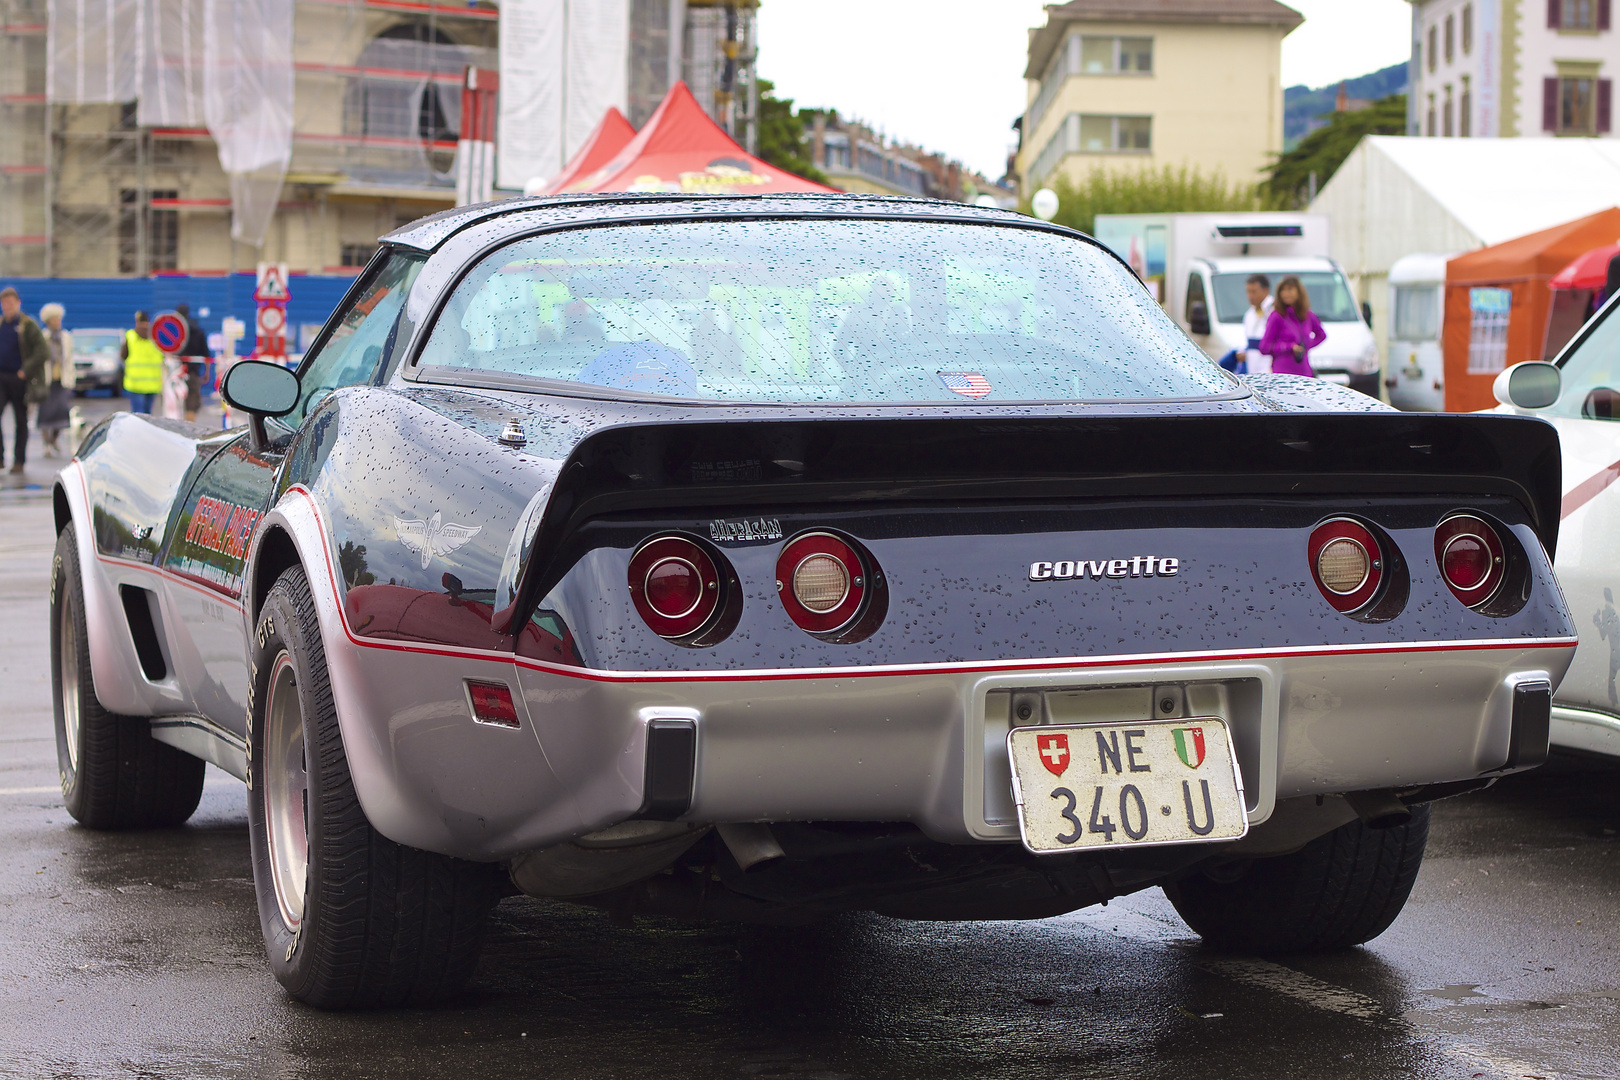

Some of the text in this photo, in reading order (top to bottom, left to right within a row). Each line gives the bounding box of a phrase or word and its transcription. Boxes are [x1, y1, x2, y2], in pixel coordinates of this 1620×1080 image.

[185, 494, 234, 555] OFFICIAL
[220, 504, 259, 561] PACE
[442, 528, 469, 539] SPEEDWAY
[709, 517, 782, 537] AMERICAN
[737, 533, 783, 541] CENTER
[1029, 555, 1179, 582] corvette
[246, 660, 259, 791] COBRA
[1095, 729, 1151, 774] NE
